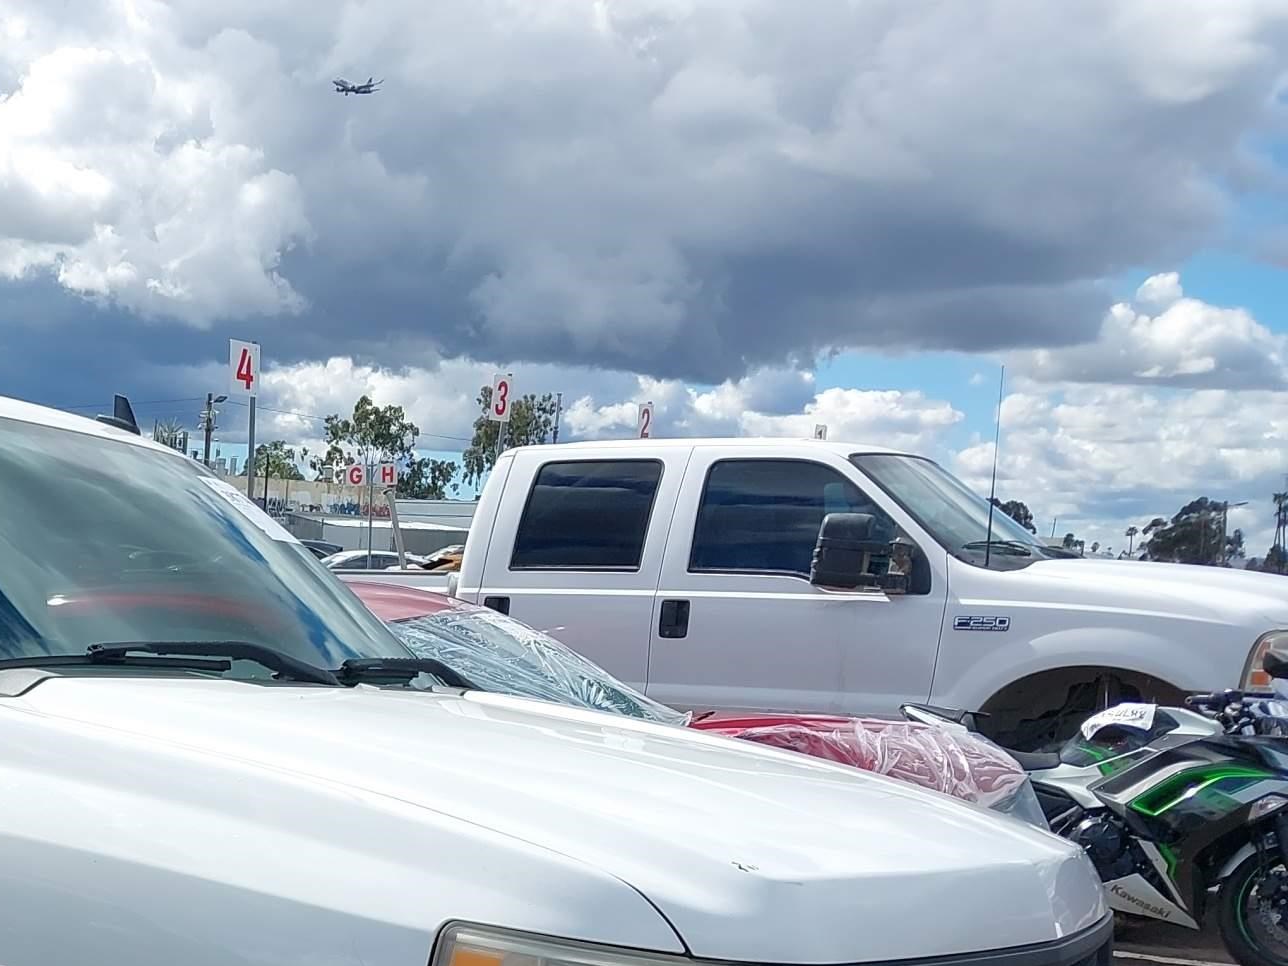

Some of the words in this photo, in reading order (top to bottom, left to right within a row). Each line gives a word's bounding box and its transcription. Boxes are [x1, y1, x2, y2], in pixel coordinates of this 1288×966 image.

[236, 348, 254, 390] 4
[494, 380, 509, 416] 3
[640, 407, 650, 438] 2
[349, 467, 363, 485] G
[381, 466, 394, 483] H
[1110, 884, 1172, 918] Kawasaki
